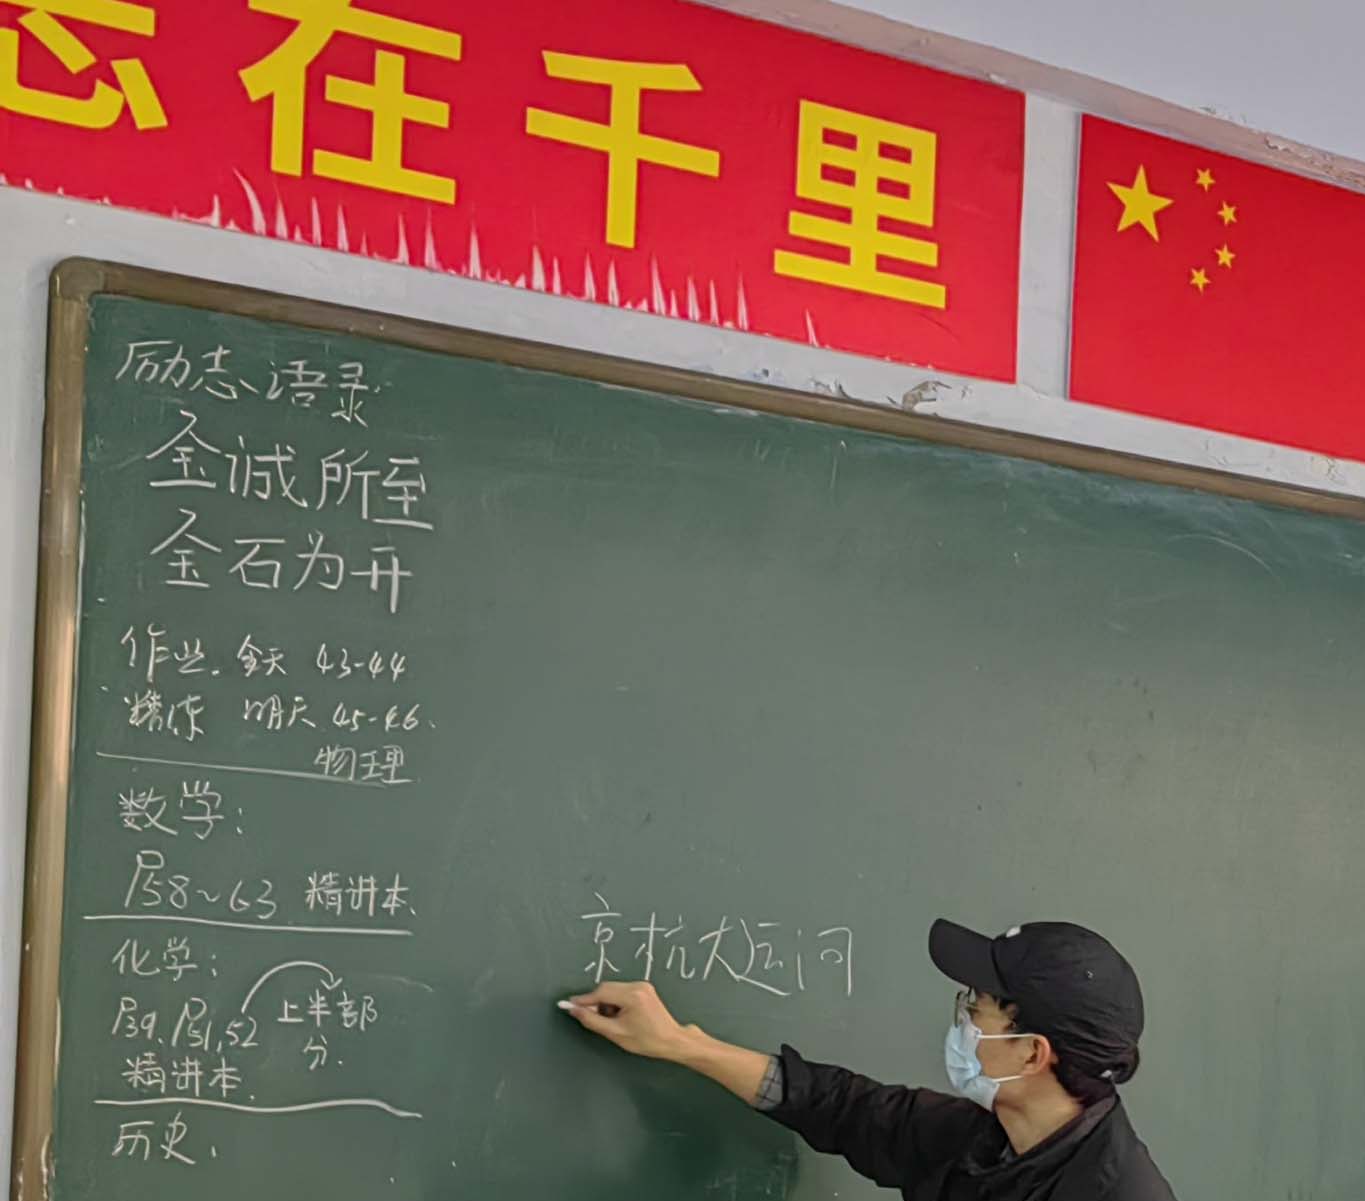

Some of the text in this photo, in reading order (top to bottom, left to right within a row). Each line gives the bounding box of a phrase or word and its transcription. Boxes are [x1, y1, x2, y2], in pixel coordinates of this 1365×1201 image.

[150, 508, 414, 614] 金石为开
[313, 745, 415, 784] 物理
